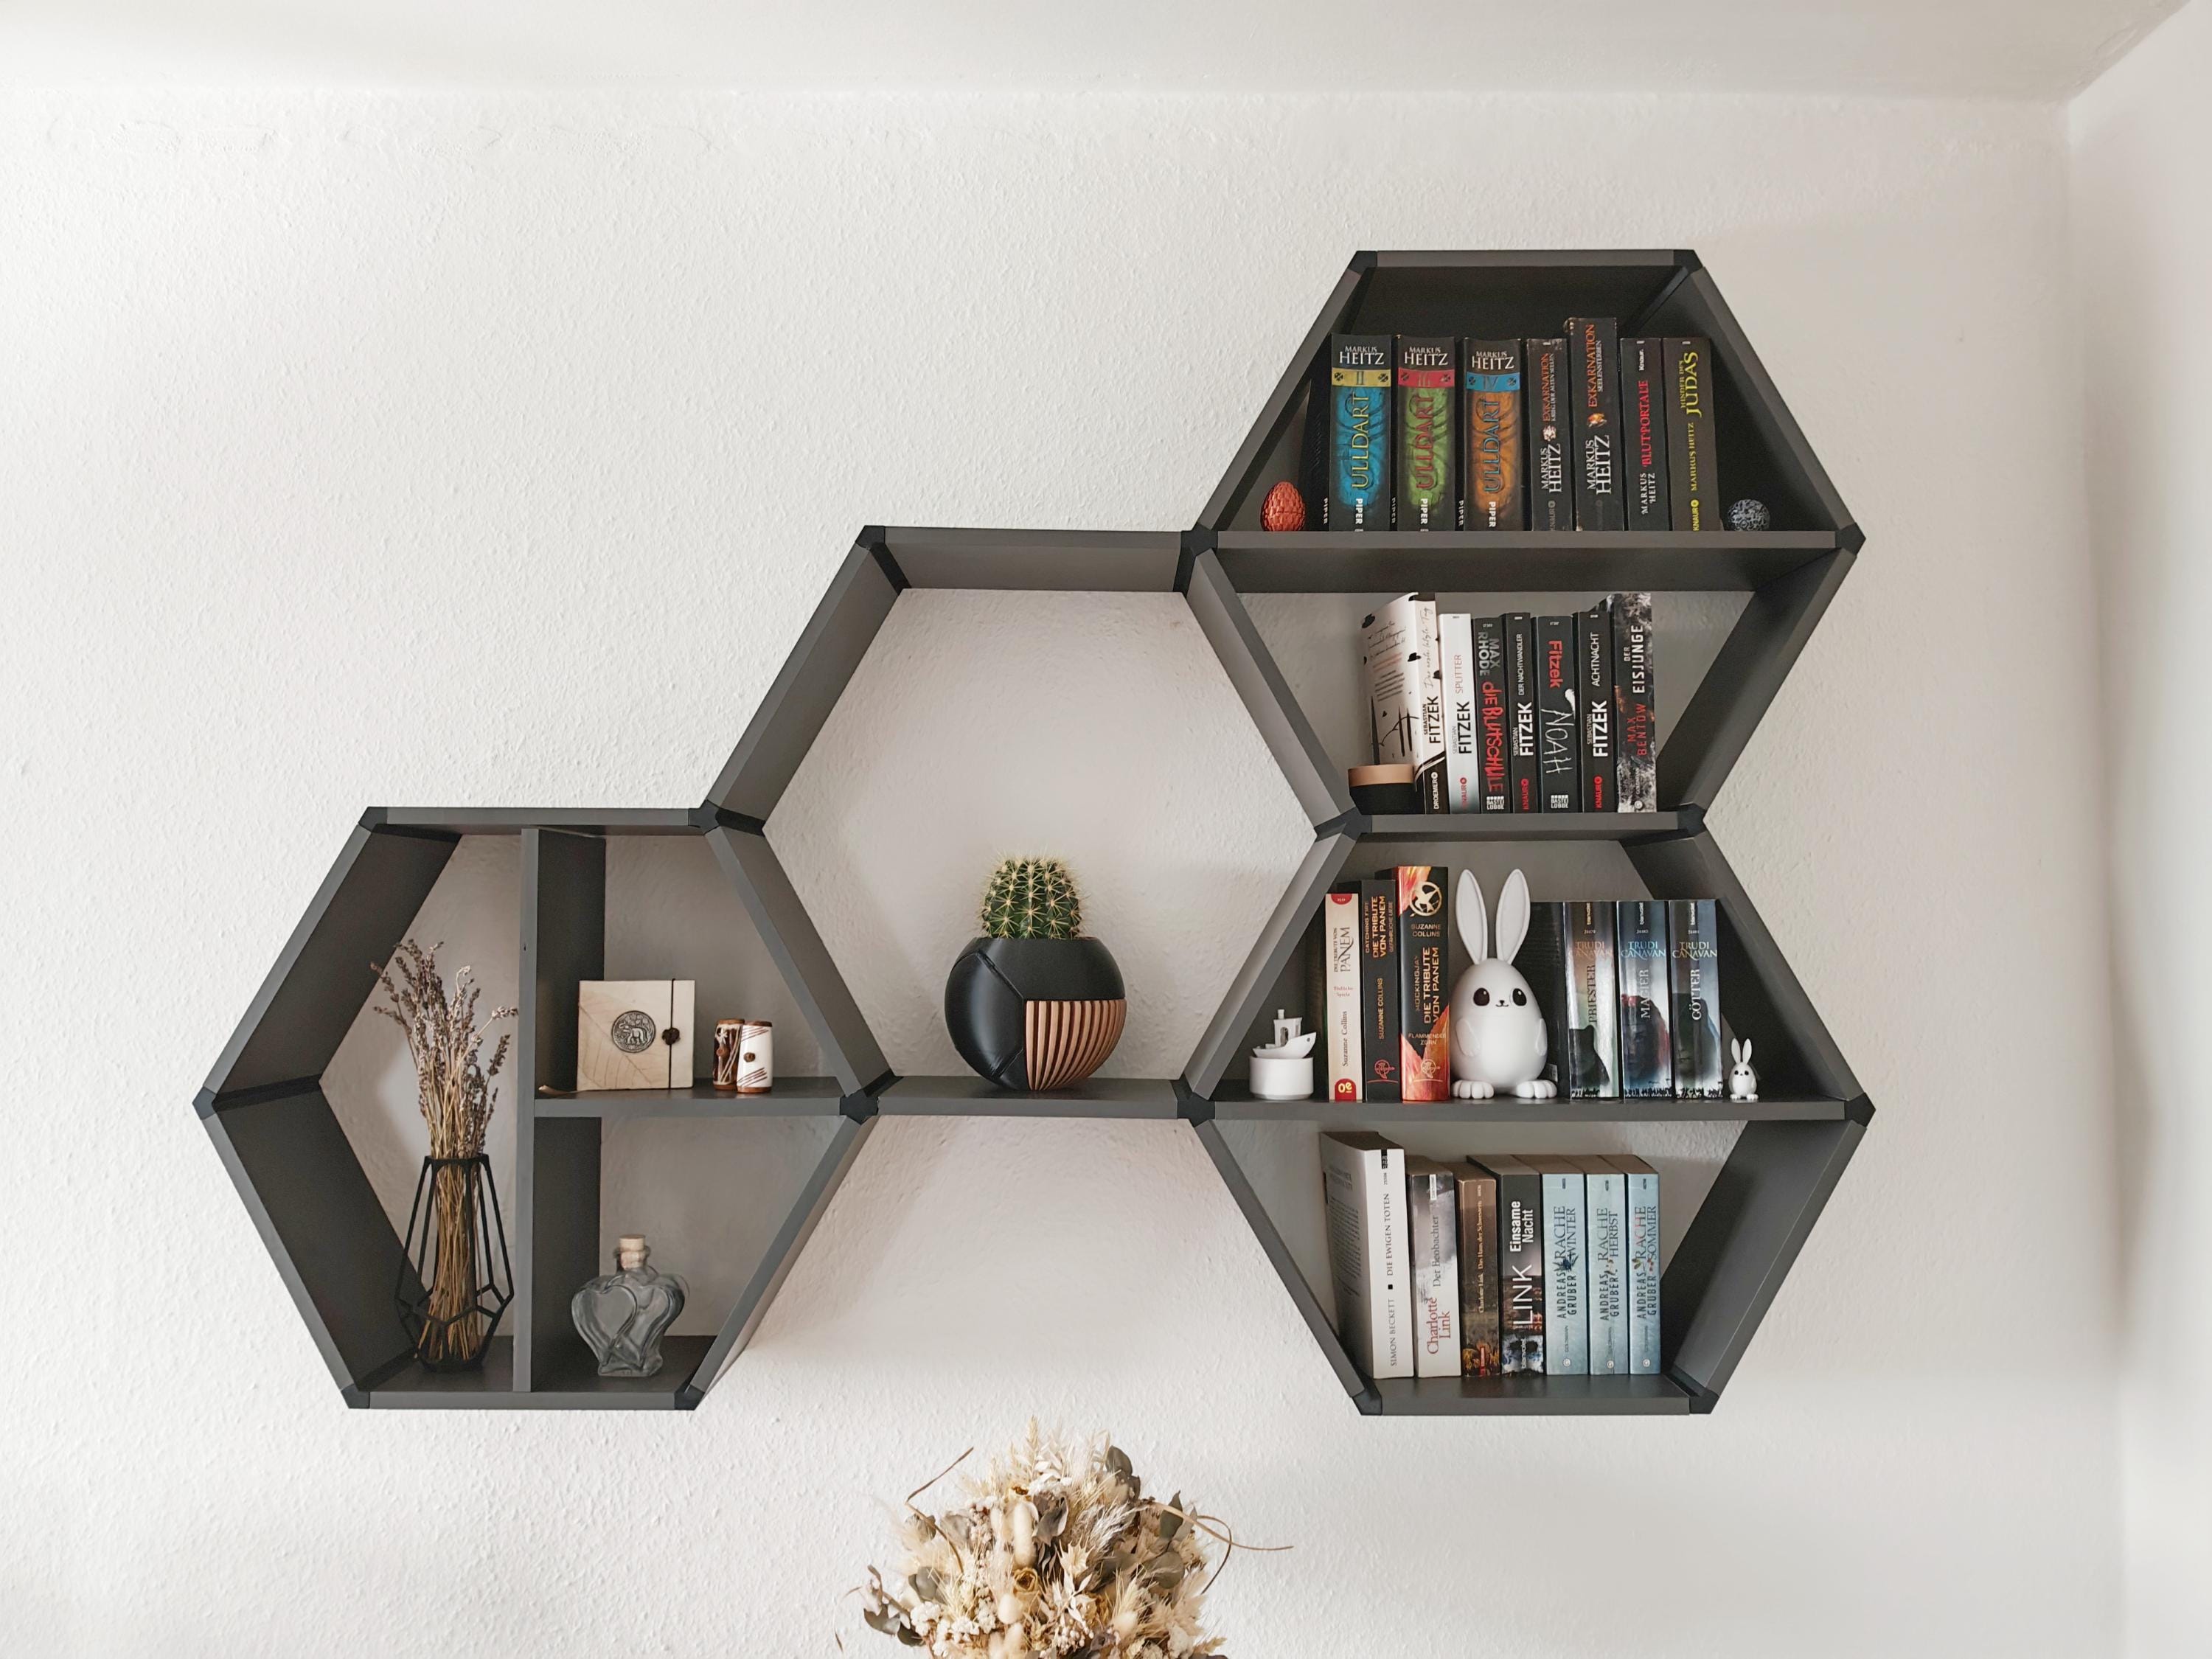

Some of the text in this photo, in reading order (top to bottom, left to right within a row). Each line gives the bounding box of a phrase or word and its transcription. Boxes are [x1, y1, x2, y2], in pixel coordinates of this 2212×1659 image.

[1339, 352, 1385, 365] HEITZ
[1404, 352, 1448, 366] HEITZ
[1472, 356, 1514, 369] HEITZ
[1585, 324, 1597, 408] EXKARNATION
[1540, 353, 1551, 422] EXKARNATION
[1683, 351, 1702, 418] JUDAS
[1352, 392, 1369, 489] ULLDART
[1416, 394, 1434, 489] ULLDART
[1484, 398, 1500, 493] ULLDART
[1638, 380, 1652, 467] BLUTPORTALE
[1540, 448, 1549, 490] MARKUS
[1548, 443, 1562, 493] HEITZ
[1586, 439, 1596, 490] MARKUS
[1594, 435, 1612, 495] HEITZ
[1687, 422, 1697, 491] MARKUS HEITZ
[1355, 498, 1363, 524] PIPER
[1420, 498, 1428, 524] PIPER
[1639, 473, 1648, 515] MARKUS
[1648, 473, 1657, 504] HEITZ
[1455, 654, 1464, 694] SPLITTER
[1478, 631, 1490, 677] RHODE
[1489, 639, 1500, 669] MAX
[1516, 633, 1524, 683] NACHTWANDLER
[1548, 640, 1563, 688] Fitzek
[1590, 633, 1600, 686] ACHTNACHT
[1631, 625, 1645, 694] EISJUNGE
[1427, 696, 1440, 744] FITZEK
[1456, 701, 1472, 754] FITZEK
[1517, 702, 1534, 757] FITZEK
[1541, 709, 1575, 774] NOAH
[1591, 700, 1608, 757] FITZEK
[1627, 717, 1636, 743] MAX
[1635, 703, 1648, 757] BENTOW
[1594, 784, 1602, 809] KNAUR
[1338, 927, 1354, 972] PANEM
[1621, 948, 1666, 960] CANAVAN
[1628, 941, 1658, 950] TRUDI
[1672, 949, 1717, 960] CANAVAN
[1680, 942, 1710, 950] TRUDI
[1422, 947, 1430, 998] TRIBUTE
[1587, 964, 1597, 1024] PRIESTER
[1639, 969, 1651, 1019] MAGIER
[1689, 969, 1701, 1020] GÖTTER
[1383, 1193, 1391, 1222] TOTEN
[1509, 1200, 1521, 1252] Einsame
[1521, 1209, 1534, 1242] Nacht
[1385, 1225, 1393, 1259] EWIGEN
[1430, 1215, 1441, 1287] Der Beobachter
[1554, 1206, 1566, 1259] RACHE
[1565, 1208, 1576, 1256] WINTER
[1596, 1208, 1609, 1262] RACHE
[1608, 1211, 1619, 1257] HERBST
[1635, 1206, 1646, 1259] RACHE
[1647, 1206, 1657, 1260] SOMMER
[1385, 1262, 1394, 1276] DIE
[1512, 1264, 1534, 1325] LINK
[1557, 1272, 1567, 1319] ANDREAS
[1567, 1275, 1577, 1315] GRUBER
[1599, 1274, 1609, 1321] ANDREAS
[1609, 1277, 1619, 1317] GRUBER
[1636, 1272, 1646, 1319] ANDREAS
[1647, 1276, 1657, 1316] GRUBER
[1388, 1299, 1397, 1366] SIMON BECKETT
[1426, 1297, 1439, 1354] Charlotte
[1439, 1311, 1451, 1339] Link
